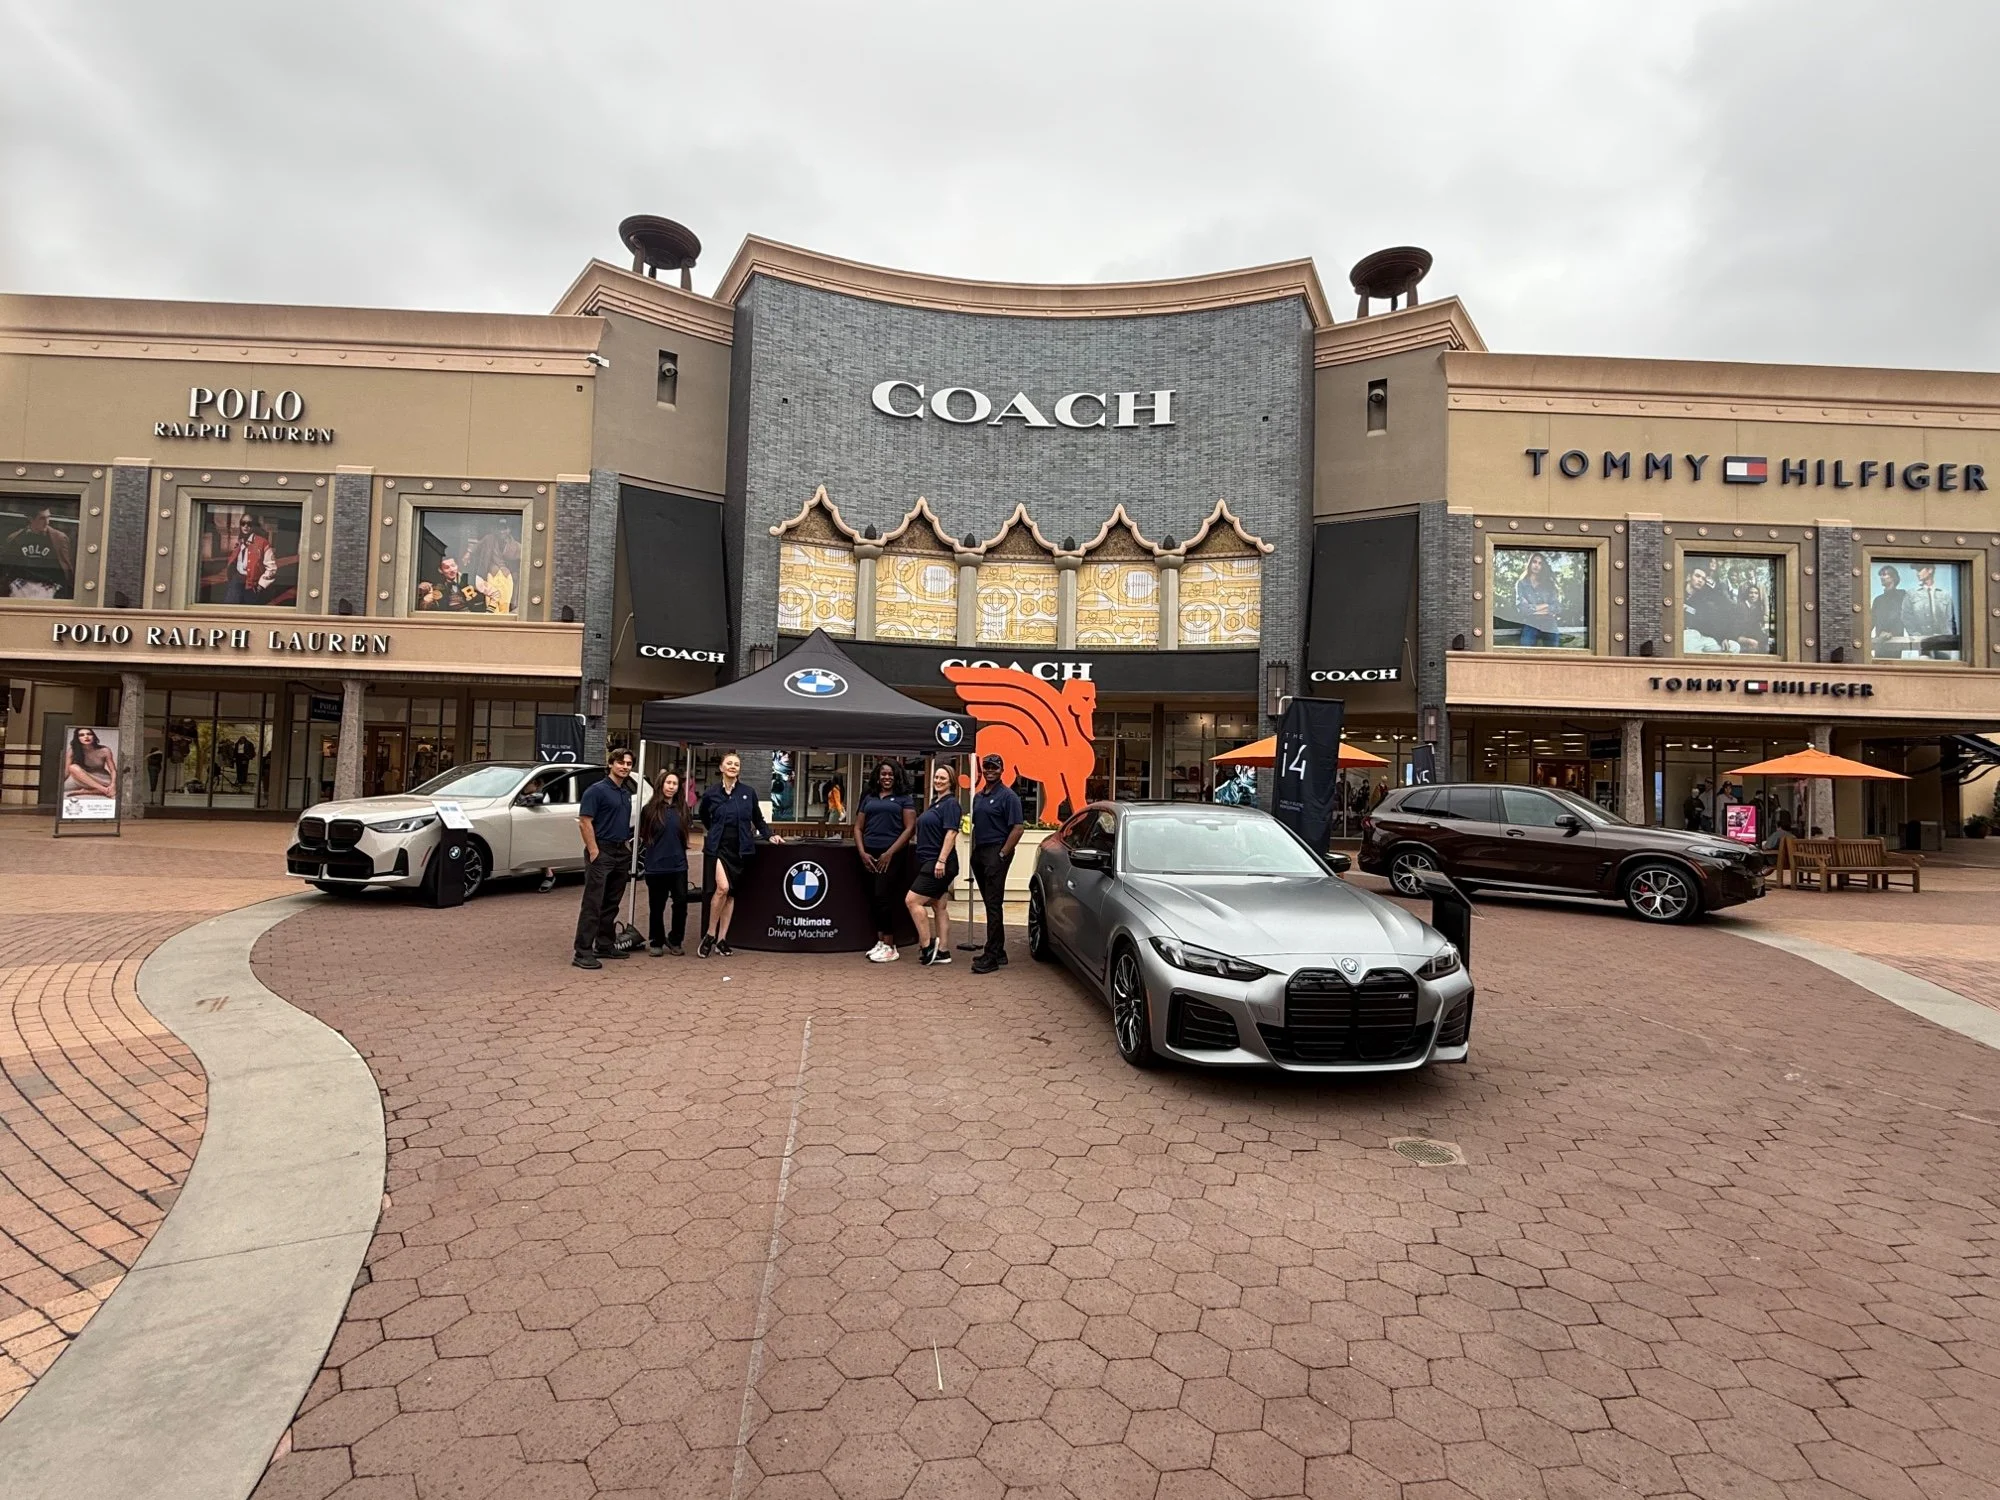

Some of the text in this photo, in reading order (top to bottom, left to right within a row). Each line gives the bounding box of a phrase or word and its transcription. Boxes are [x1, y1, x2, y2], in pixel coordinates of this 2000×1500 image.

[188, 387, 304, 421] POLO
[871, 380, 1176, 428] COACH
[154, 422, 334, 443] RALPH LAUREN
[1525, 448, 1989, 492] TOMMY HILFIGER
[21, 544, 50, 556] POLO
[51, 622, 391, 653] POLO RALPH LAUREN
[640, 645, 726, 664] COACH
[1310, 668, 1398, 682] COACH
[1648, 677, 1875, 698] TOMMY HILFIGER
[1284, 732, 1304, 740] THE
[1281, 742, 1307, 780] i4
[776, 915, 832, 926] The Ultimate
[767, 927, 797, 940] Driving
